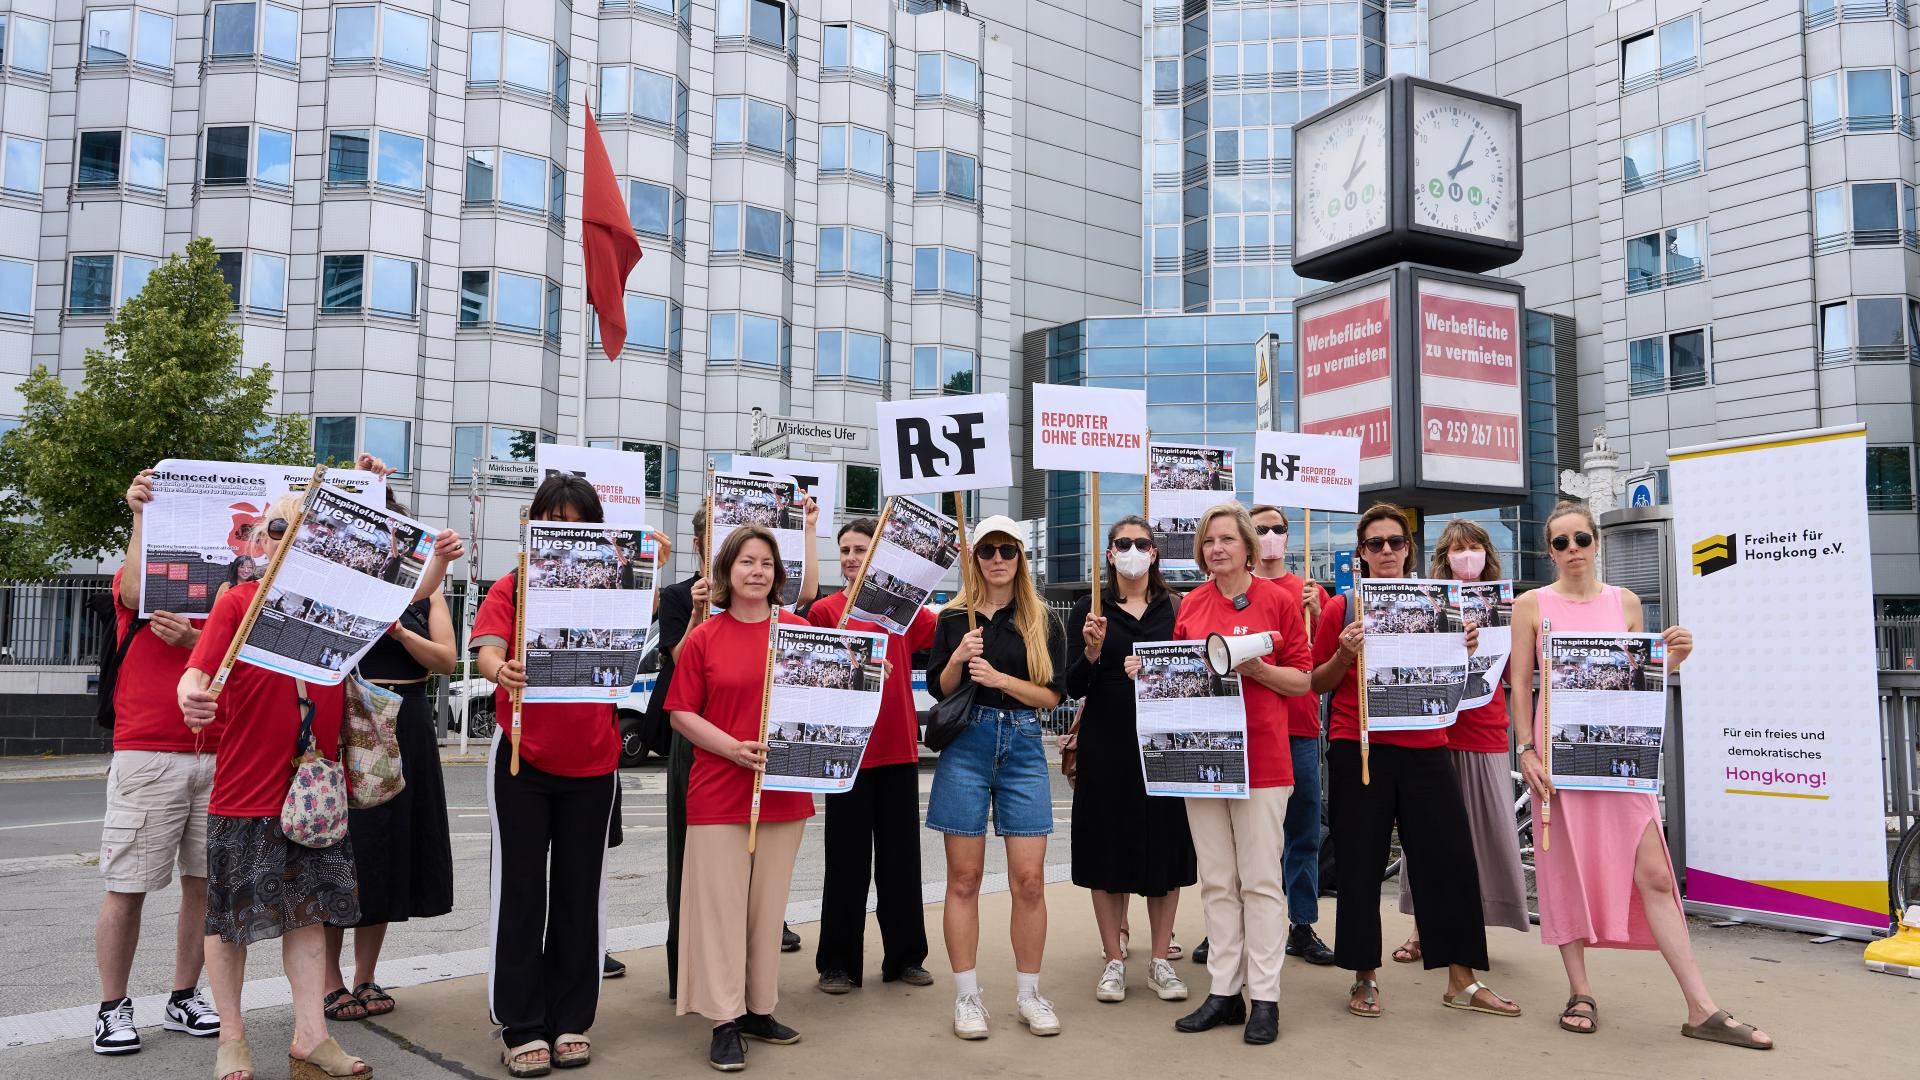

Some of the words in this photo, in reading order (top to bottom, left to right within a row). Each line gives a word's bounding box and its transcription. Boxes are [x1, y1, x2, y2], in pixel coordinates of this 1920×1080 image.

[1433, 121, 1440, 129] 11
[1451, 118, 1459, 128] 12
[1420, 134, 1428, 144] 10
[1485, 148, 1490, 158] 2
[1416, 158, 1420, 166] 9
[1491, 174, 1496, 183] 3
[1420, 184, 1426, 192] 8
[1434, 204, 1438, 212] 7
[1454, 214, 1458, 223] 6
[1473, 211, 1478, 220] 5
[1424, 312, 1508, 341] Werbefläche
[1306, 318, 1382, 352] Werbefläche
[1306, 364, 1320, 378] zu
[1324, 346, 1387, 374] vermieten
[1425, 344, 1442, 358] zu
[1445, 346, 1513, 368] vermieten
[1042, 412, 1108, 430] REPORTER
[777, 422, 832, 438] Märkisches
[834, 427, 856, 440] Ufer
[1369, 420, 1388, 444] 111
[1446, 420, 1468, 444] 259
[1472, 424, 1492, 446] 267
[1496, 426, 1515, 448] 111
[1042, 430, 1076, 446] OHNE
[1081, 432, 1141, 448] GRENZEN
[896, 412, 986, 480] RSF
[1152, 454, 1179, 464] lives
[488, 464, 524, 472] Märkisches
[1260, 452, 1301, 482] RSF
[1300, 466, 1336, 476] REPORTER
[152, 471, 216, 482] Silenced
[220, 476, 266, 485] voices
[1300, 475, 1320, 484] OHNE
[1321, 476, 1353, 486] GRENZEN
[592, 484, 624, 494] EPORTER
[716, 484, 748, 496] lives
[748, 488, 763, 498] on
[608, 495, 640, 505] GRENZEN
[312, 498, 352, 525] lives
[353, 520, 377, 534] on
[320, 490, 336, 503] The
[336, 497, 359, 513] spirit
[358, 507, 370, 517] of
[367, 512, 394, 527] Apple
[392, 521, 414, 536] Daily
[532, 528, 551, 536] The
[550, 530, 574, 538] spirit
[585, 531, 608, 539] Apple
[1744, 532, 1798, 546] Freiheit
[1803, 529, 1824, 542] für
[532, 536, 574, 551] lives
[575, 540, 597, 551] on
[1746, 546, 1817, 562] Hongkong
[1822, 542, 1845, 555] e.V.
[1424, 585, 1442, 593] Daily
[1364, 592, 1398, 602] lives
[1399, 593, 1416, 602] on
[1233, 626, 1248, 635] RSF
[795, 632, 816, 640] spirit
[824, 634, 847, 644] Apple
[848, 637, 866, 646] Daily
[778, 638, 813, 652] lives
[815, 644, 834, 654] on
[1553, 646, 1588, 657] lives
[1590, 648, 1610, 657] on
[1143, 656, 1170, 666] ives
[1172, 656, 1189, 666] on
[1724, 728, 1742, 738] Für
[1744, 728, 1762, 738] ein
[1764, 729, 1798, 740] freies
[1800, 730, 1825, 740] und
[1728, 746, 1822, 760] demokratisches
[1726, 766, 1827, 788] Hongkong!
